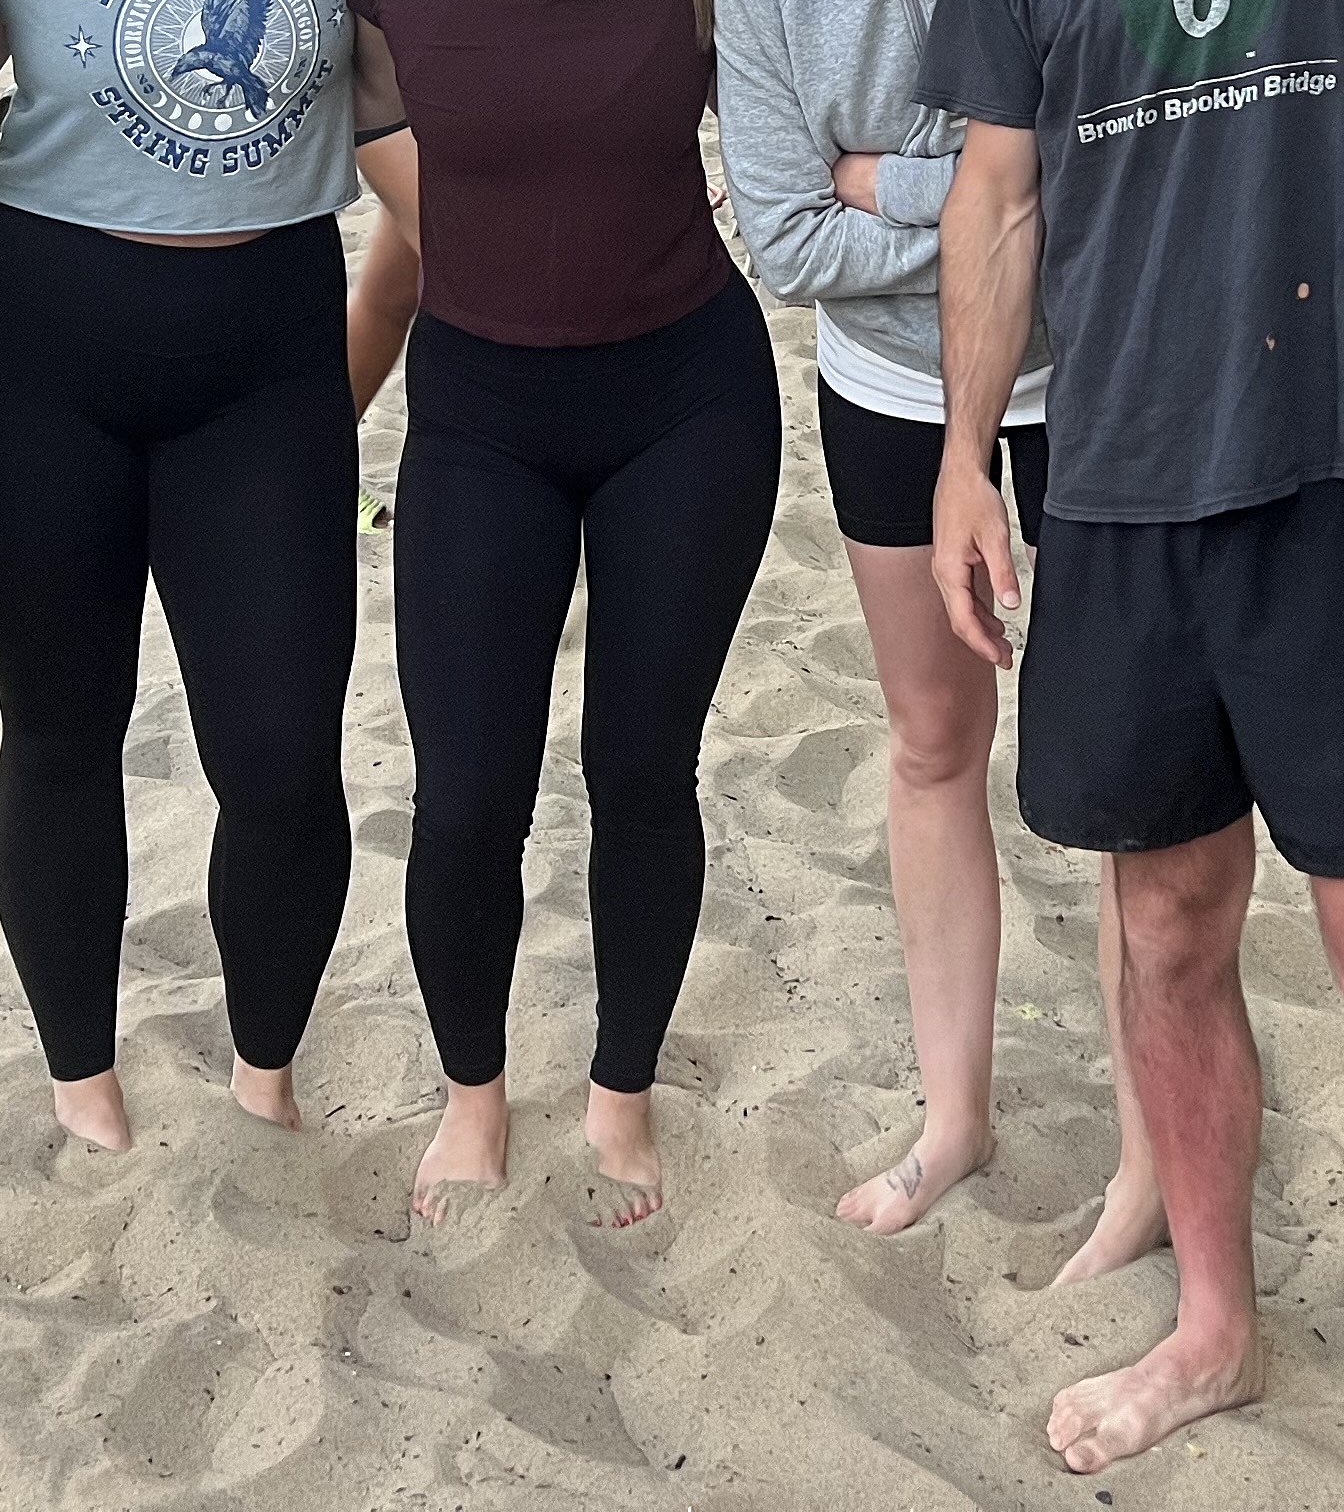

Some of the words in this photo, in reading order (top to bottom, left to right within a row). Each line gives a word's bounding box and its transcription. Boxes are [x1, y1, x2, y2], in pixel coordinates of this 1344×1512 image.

[89, 86, 211, 177] STRING
[221, 59, 335, 176] SUMMIT
[1077, 113, 1135, 144] Bronx
[1135, 107, 1158, 128] to
[1164, 84, 1259, 121] Brooklyn
[1263, 70, 1337, 97] Bridge
